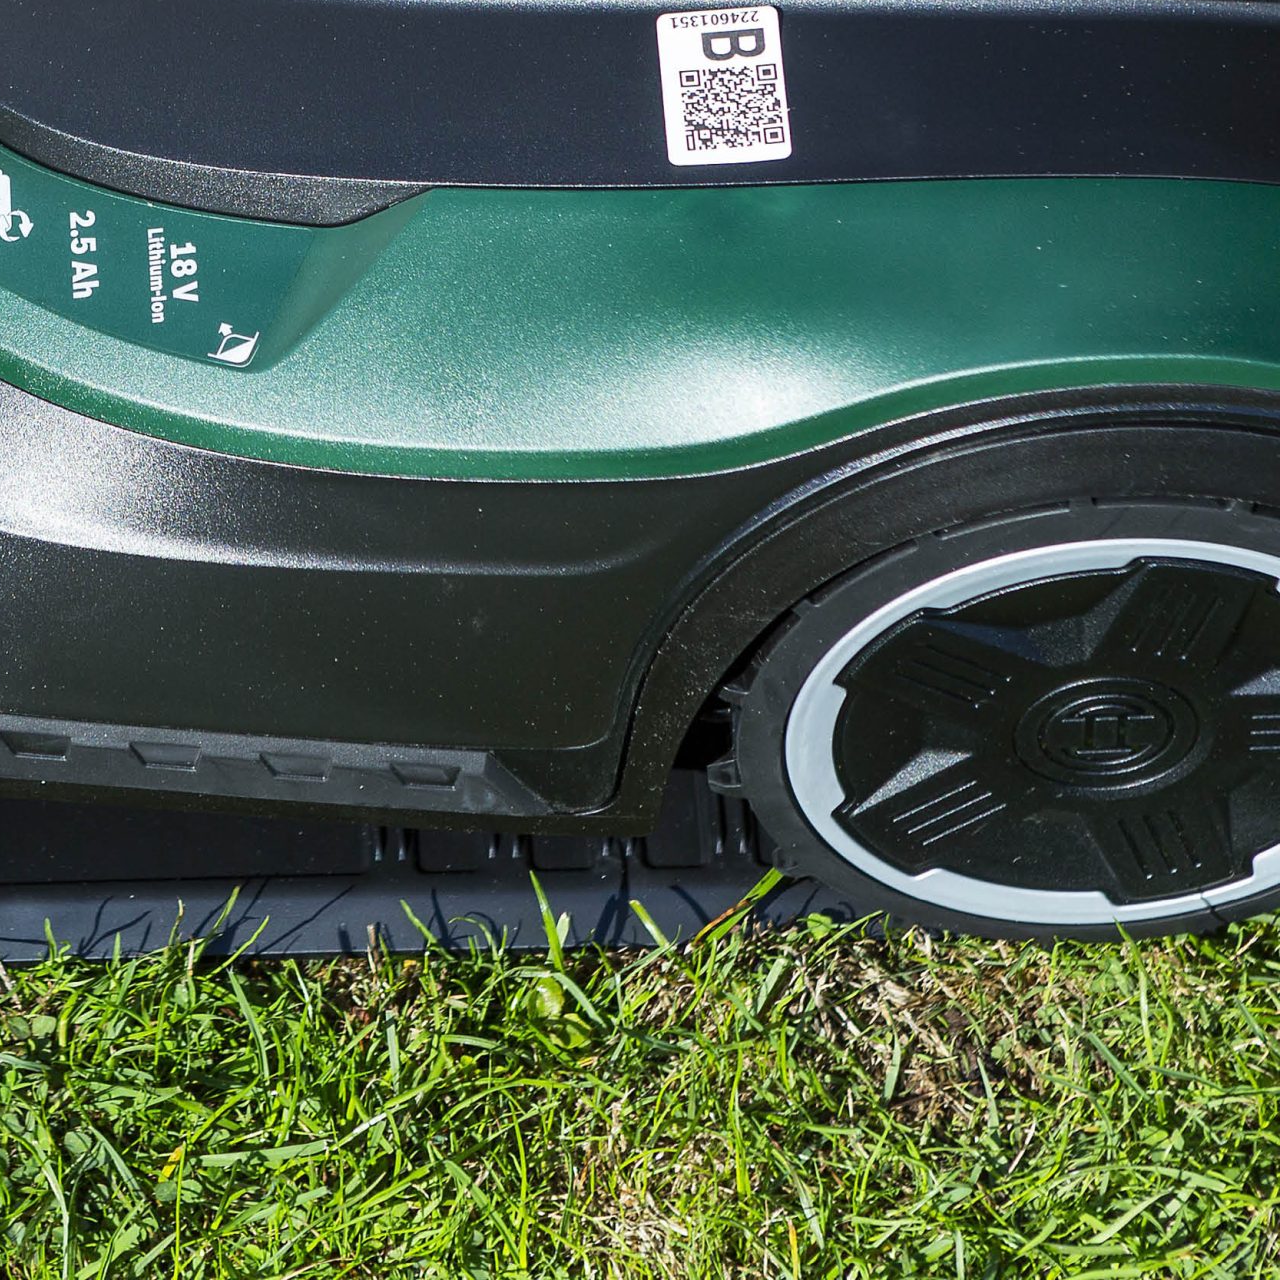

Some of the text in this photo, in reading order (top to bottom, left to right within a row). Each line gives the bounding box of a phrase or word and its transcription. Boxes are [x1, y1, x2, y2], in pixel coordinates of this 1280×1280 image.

[669, 10, 760, 29] 224601351
[701, 27, 766, 61] B
[70, 209, 100, 299] 2.5 Ah
[147, 227, 168, 324] Lithium-Ion
[170, 241, 200, 302] 18 V
